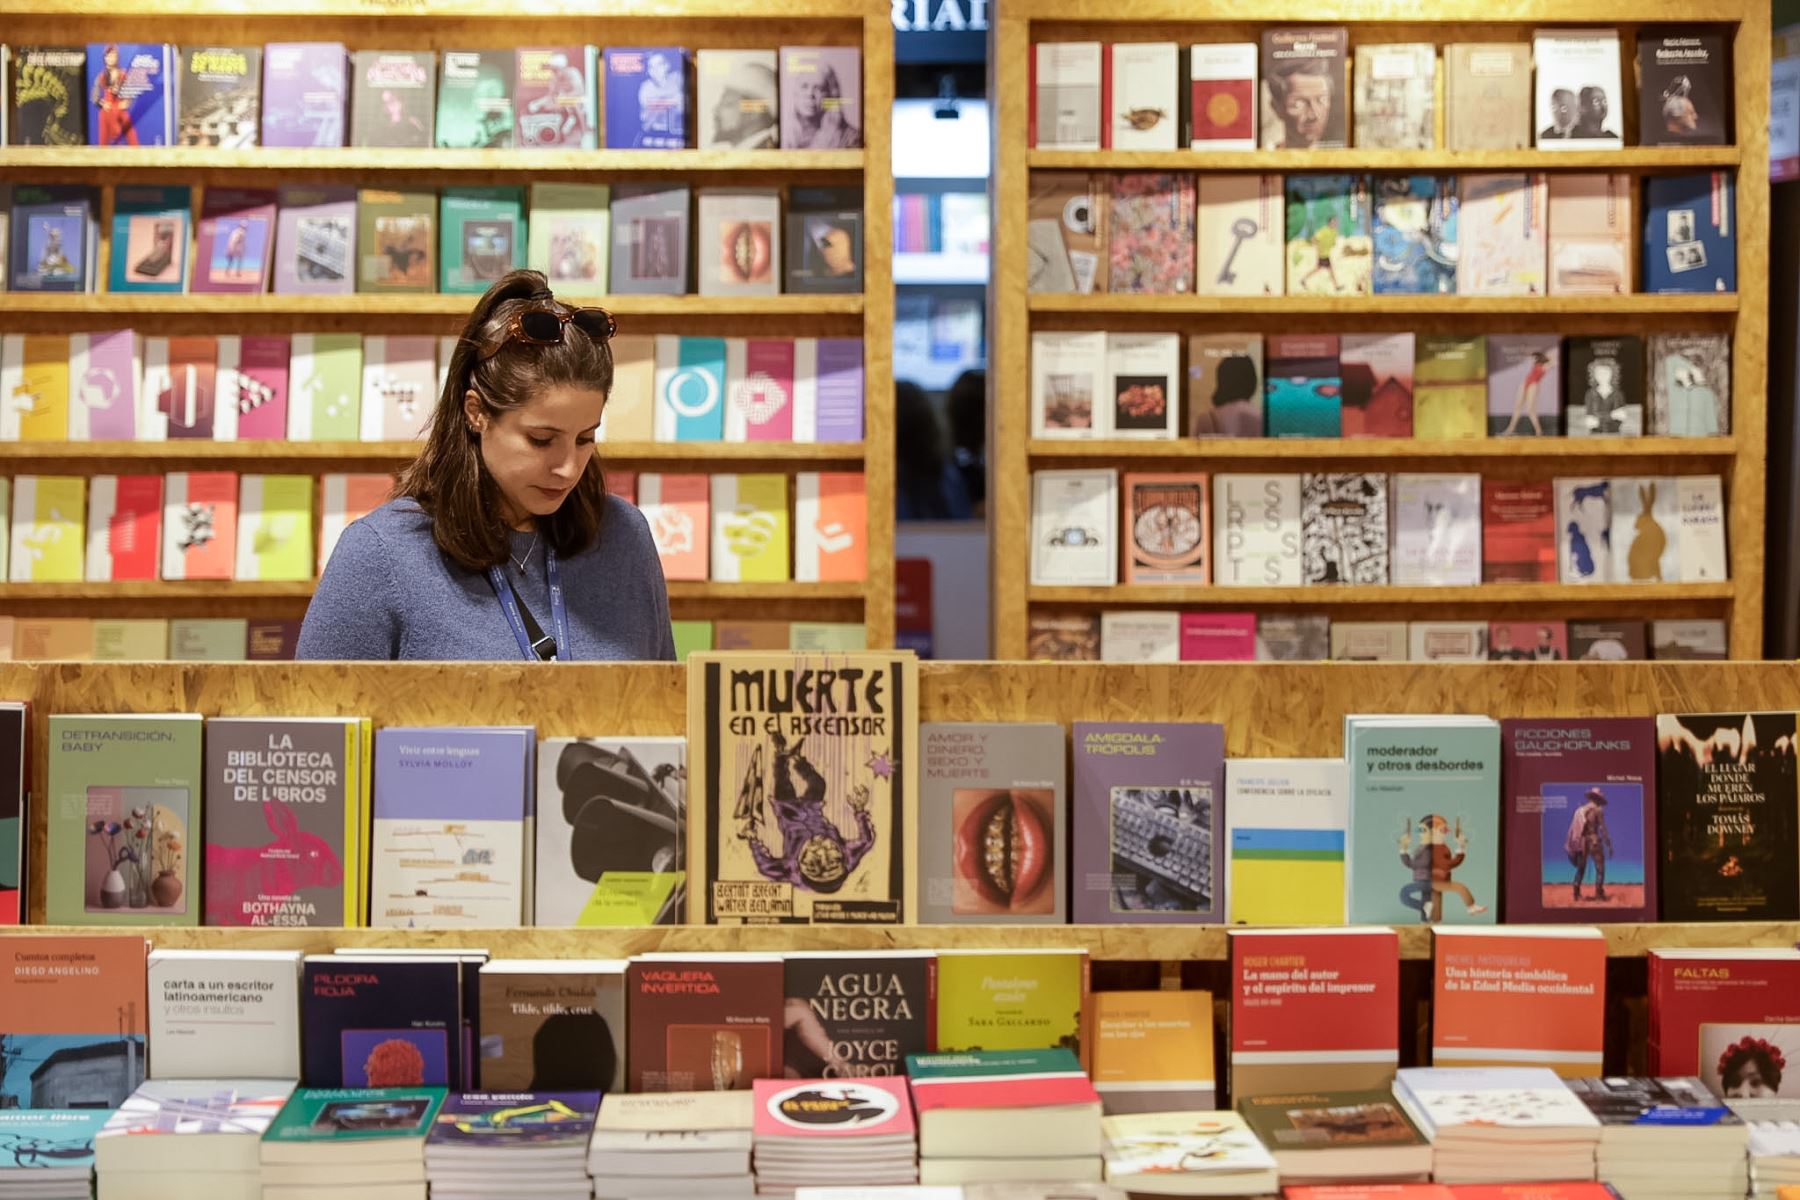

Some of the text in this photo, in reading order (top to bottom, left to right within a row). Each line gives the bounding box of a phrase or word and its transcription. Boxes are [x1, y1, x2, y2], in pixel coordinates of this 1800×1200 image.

[731, 669, 884, 713] MUERTE
[729, 716, 755, 735] EN
[791, 716, 885, 736] ASCENSOR
[928, 733, 988, 742] AMOR Y
[1514, 729, 1591, 739] FICCIONES
[268, 733, 293, 750] LA
[1514, 740, 1631, 750] GAUCHOPUNKS
[61, 743, 103, 752] BABY
[399, 745, 480, 758] Vivir entre lenguas
[1366, 745, 1438, 756] moderador
[227, 751, 333, 768] BIBLIOTECA
[399, 760, 473, 768] SYLVIA MOLLOY
[927, 757, 983, 766] SEXO Y
[1366, 760, 1484, 772] y otros desbordes
[1704, 763, 1756, 773] EL LUGAR
[223, 768, 337, 786] DEL CENSOR
[927, 768, 989, 778] MUERTE
[1711, 774, 1750, 783] DONDE
[234, 786, 258, 801] DE
[1707, 784, 1753, 792] MUEREN
[1696, 794, 1716, 804] LOS
[1707, 825, 1755, 834] DOWNEY
[242, 902, 316, 914] BOTHAYNA
[717, 899, 791, 913] WALTER BENJAMIN
[251, 915, 308, 926] AL-ESSA
[14, 953, 95, 963] Cuentos completos
[14, 966, 100, 976] DIEGO ANGELINO
[641, 971, 715, 982] VAQUERA
[1243, 968, 1339, 981] La mano del autor
[1445, 966, 1568, 981] Una historia simbólica
[1674, 968, 1729, 978] FALTAS
[163, 980, 195, 990] carta
[209, 982, 224, 990] un
[227, 981, 274, 990] escritor
[641, 983, 720, 993] INVERTIDA
[817, 973, 905, 997] AGUA
[1243, 984, 1251, 995] y
[1252, 982, 1263, 993] el
[1308, 982, 1325, 993] del
[1327, 982, 1376, 995] impresor
[1445, 980, 1594, 994] de la Edad Media occidental
[313, 986, 356, 996] ROJA
[164, 992, 263, 1003] latinoamericano
[173, 1005, 200, 1014] otros
[510, 1002, 592, 1015] Tilde, tilde, cruz
[809, 997, 913, 1020] NEGRA
[968, 1017, 1051, 1026] SARA GALLARDO
[827, 1040, 898, 1060] JOYCE
